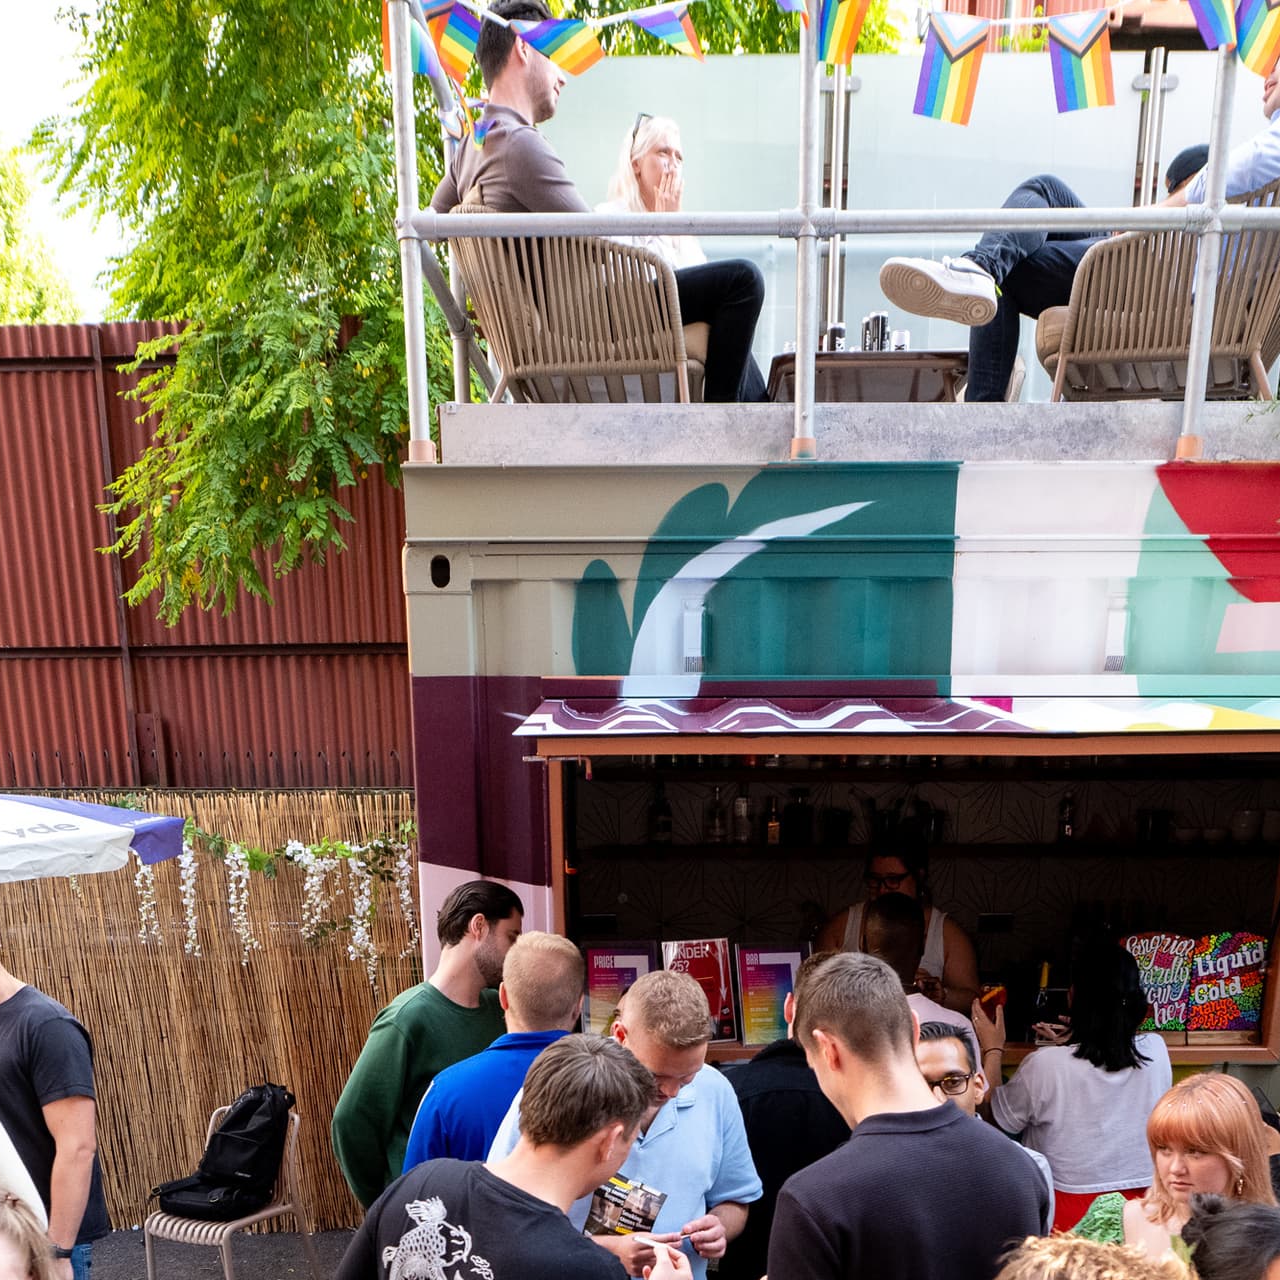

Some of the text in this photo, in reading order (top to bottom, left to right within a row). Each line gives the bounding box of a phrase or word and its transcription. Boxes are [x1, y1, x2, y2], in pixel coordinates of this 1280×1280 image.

[593, 955, 614, 969] PRICE
[672, 945, 708, 960] NDER
[1195, 941, 1265, 978] Liquid
[1194, 976, 1243, 1005] Gold
[1153, 1001, 1186, 1028] her
